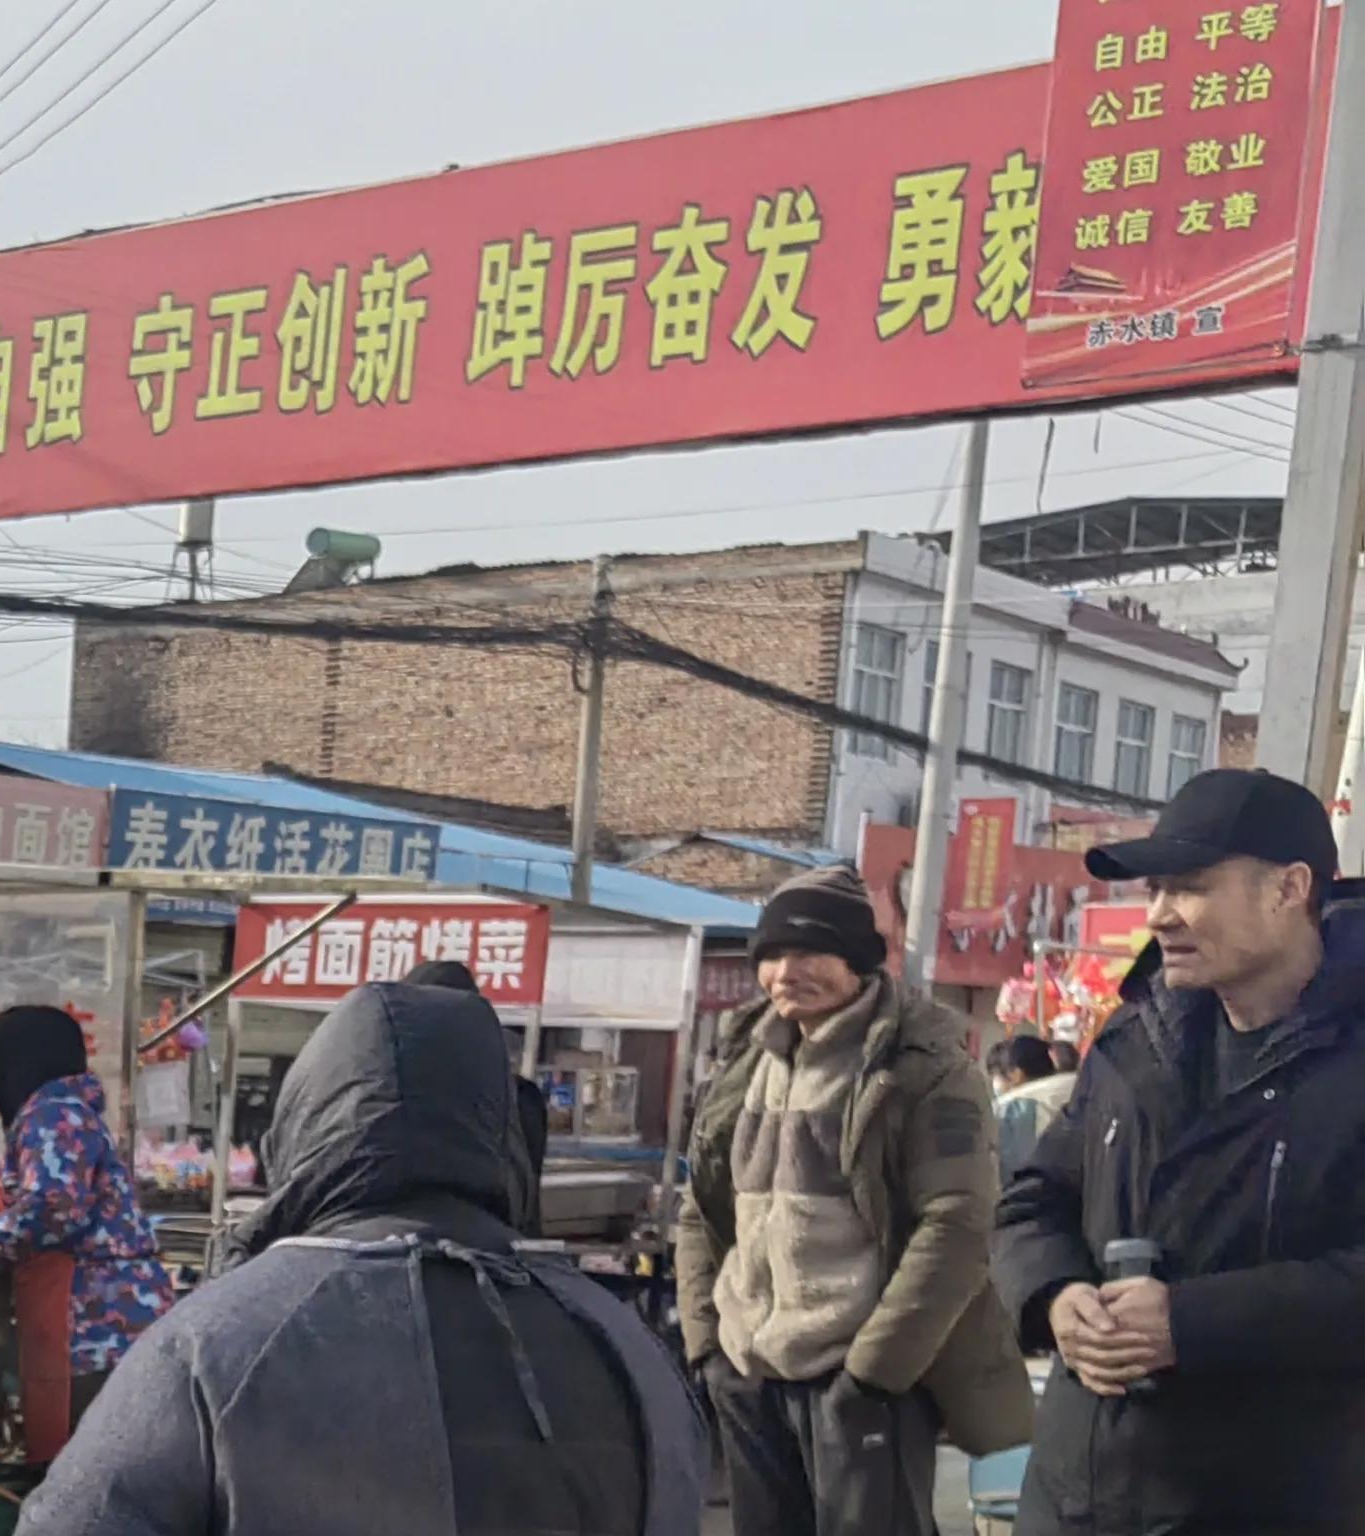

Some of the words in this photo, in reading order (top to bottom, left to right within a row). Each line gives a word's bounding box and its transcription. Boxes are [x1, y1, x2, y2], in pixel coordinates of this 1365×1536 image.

[1095, 25, 1169, 71] 自由
[1195, 3, 1278, 50] 平等
[1086, 83, 1165, 128] 公正
[1190, 63, 1273, 111] 法治
[1082, 148, 1161, 194] 爱国
[1185, 132, 1266, 177] 敬业
[1075, 208, 1154, 250] 诚信
[1177, 191, 1258, 236] 友善
[128, 250, 430, 435] 守正创新
[465, 188, 823, 388] 踔厉奋发
[1086, 310, 1177, 348] 赤水镇
[1194, 304, 1226, 335] 宣
[260, 916, 528, 990] 烤面筋烤菜
